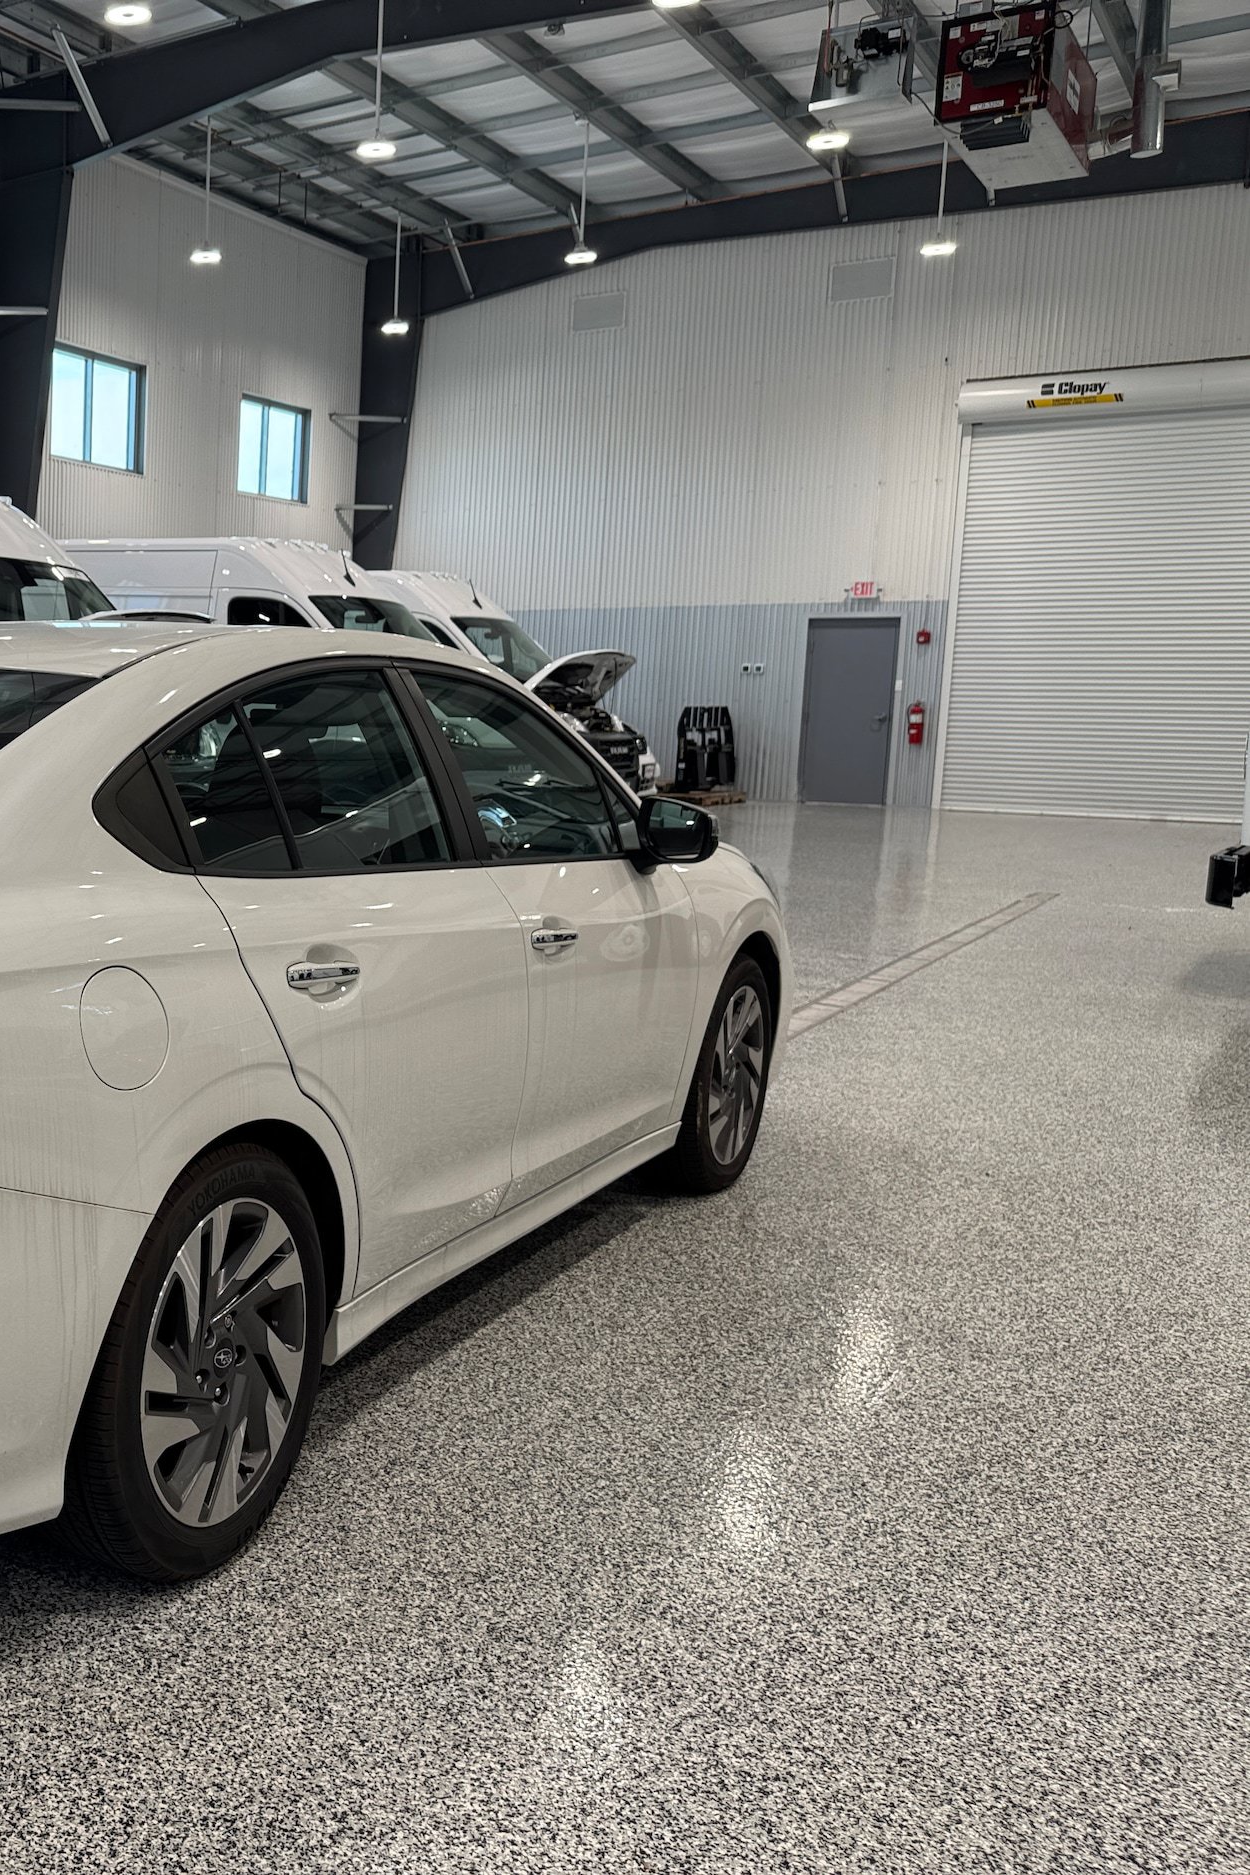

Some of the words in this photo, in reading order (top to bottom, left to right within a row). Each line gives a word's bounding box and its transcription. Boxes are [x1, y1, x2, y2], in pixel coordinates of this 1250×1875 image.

[1058, 381, 1107, 396] Clopay
[853, 582, 874, 596] EXIT
[187, 1163, 256, 1217] YOKOHAMA
